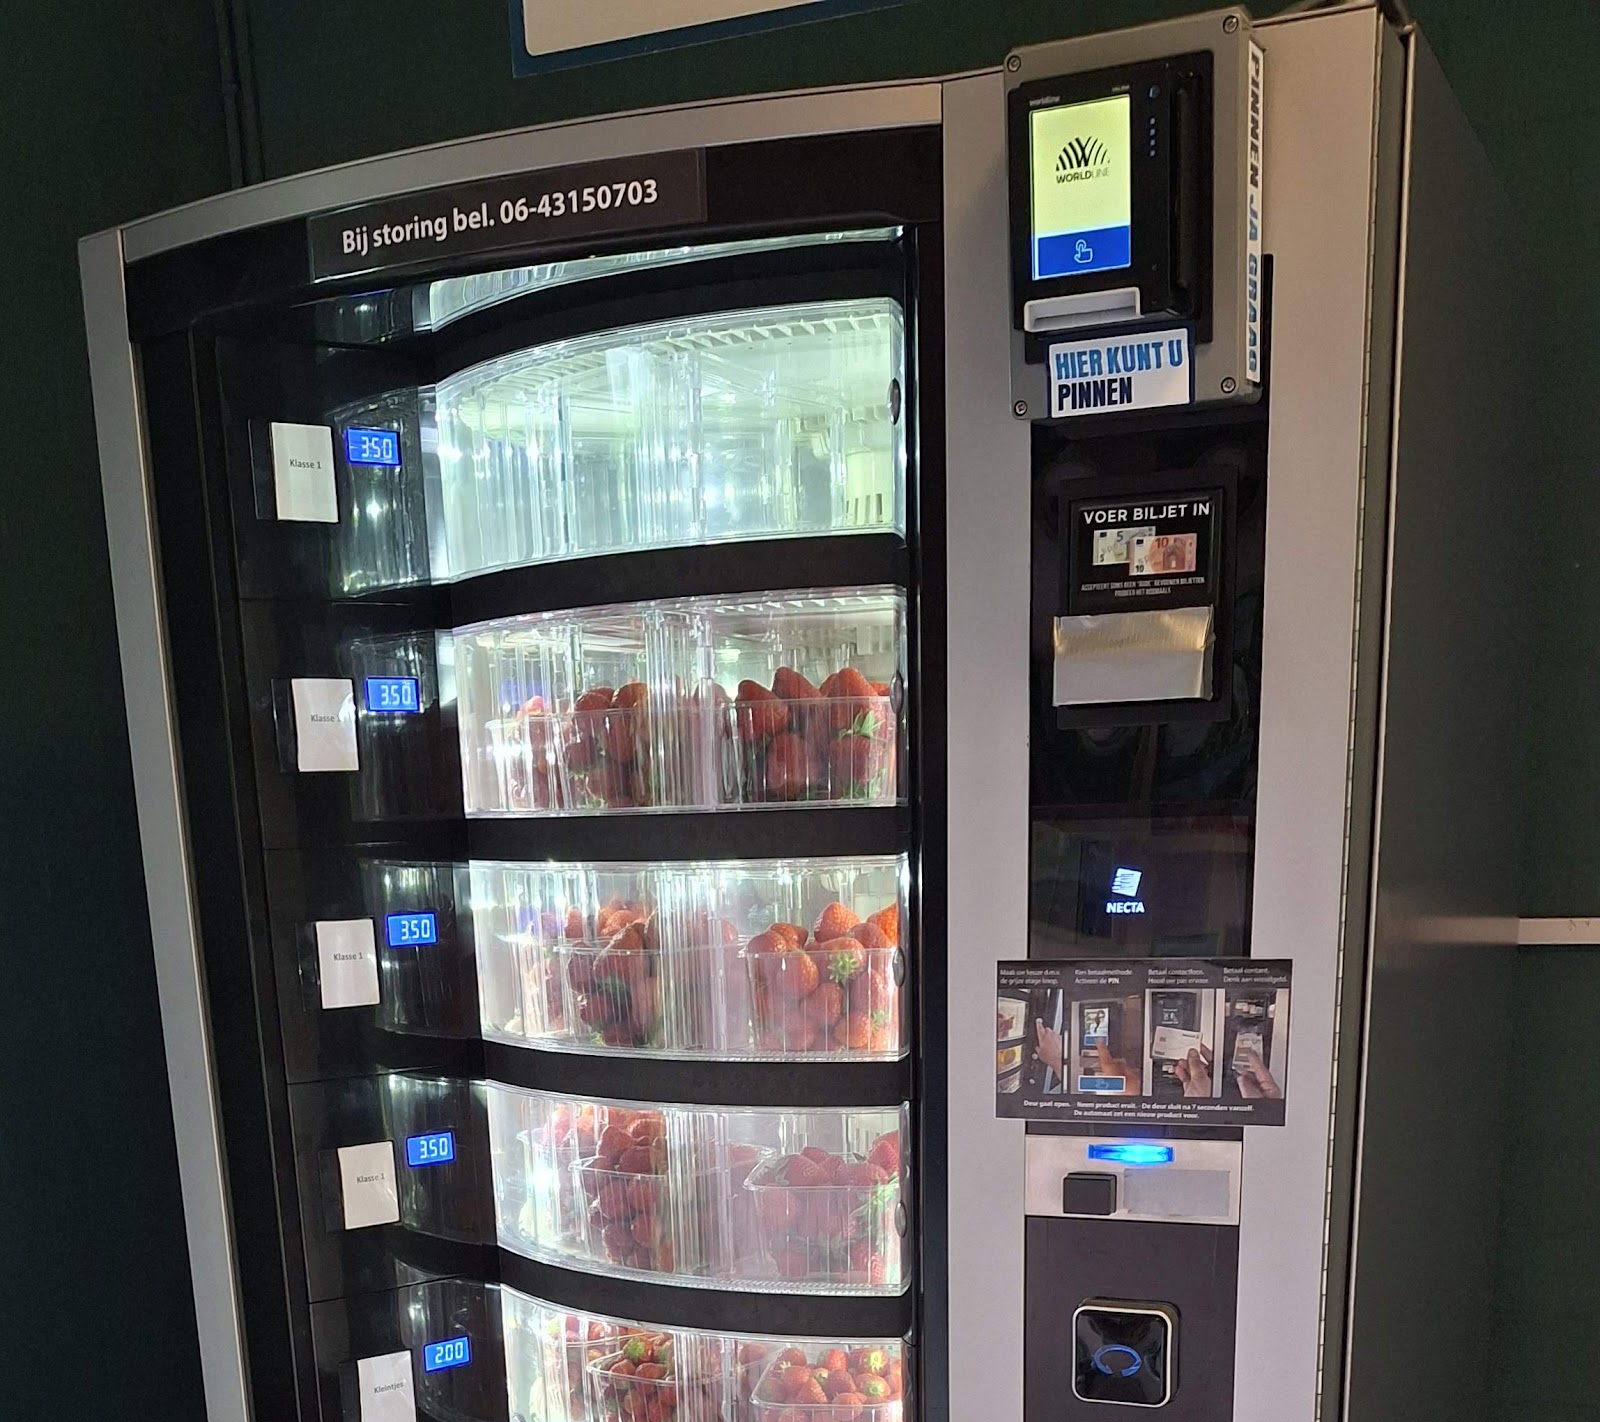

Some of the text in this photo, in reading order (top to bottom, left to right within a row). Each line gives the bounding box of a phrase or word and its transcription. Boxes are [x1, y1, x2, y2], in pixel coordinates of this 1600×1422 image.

[1056, 167, 1110, 184] WORLDLINE
[342, 178, 659, 257] Bij storing bel. 06-43150703
[1248, 51, 1260, 373] PINNEN JA GRAAG
[1055, 339, 1183, 380] HIER KUNT U
[1057, 376, 1133, 411] PINNEN
[290, 458, 322, 469] Klasse 1
[1084, 502, 1210, 525] VOER BILJET IN
[1116, 531, 1124, 542] 5
[1155, 537, 1169, 549] 10
[1135, 564, 1144, 573] 10
[310, 714, 335, 722] Klasse
[1106, 901, 1145, 913] NECTA
[333, 952, 363, 961] Klasse 1
[356, 1174, 379, 1183] Klasse
[374, 1381, 404, 1394] Kleintjes
